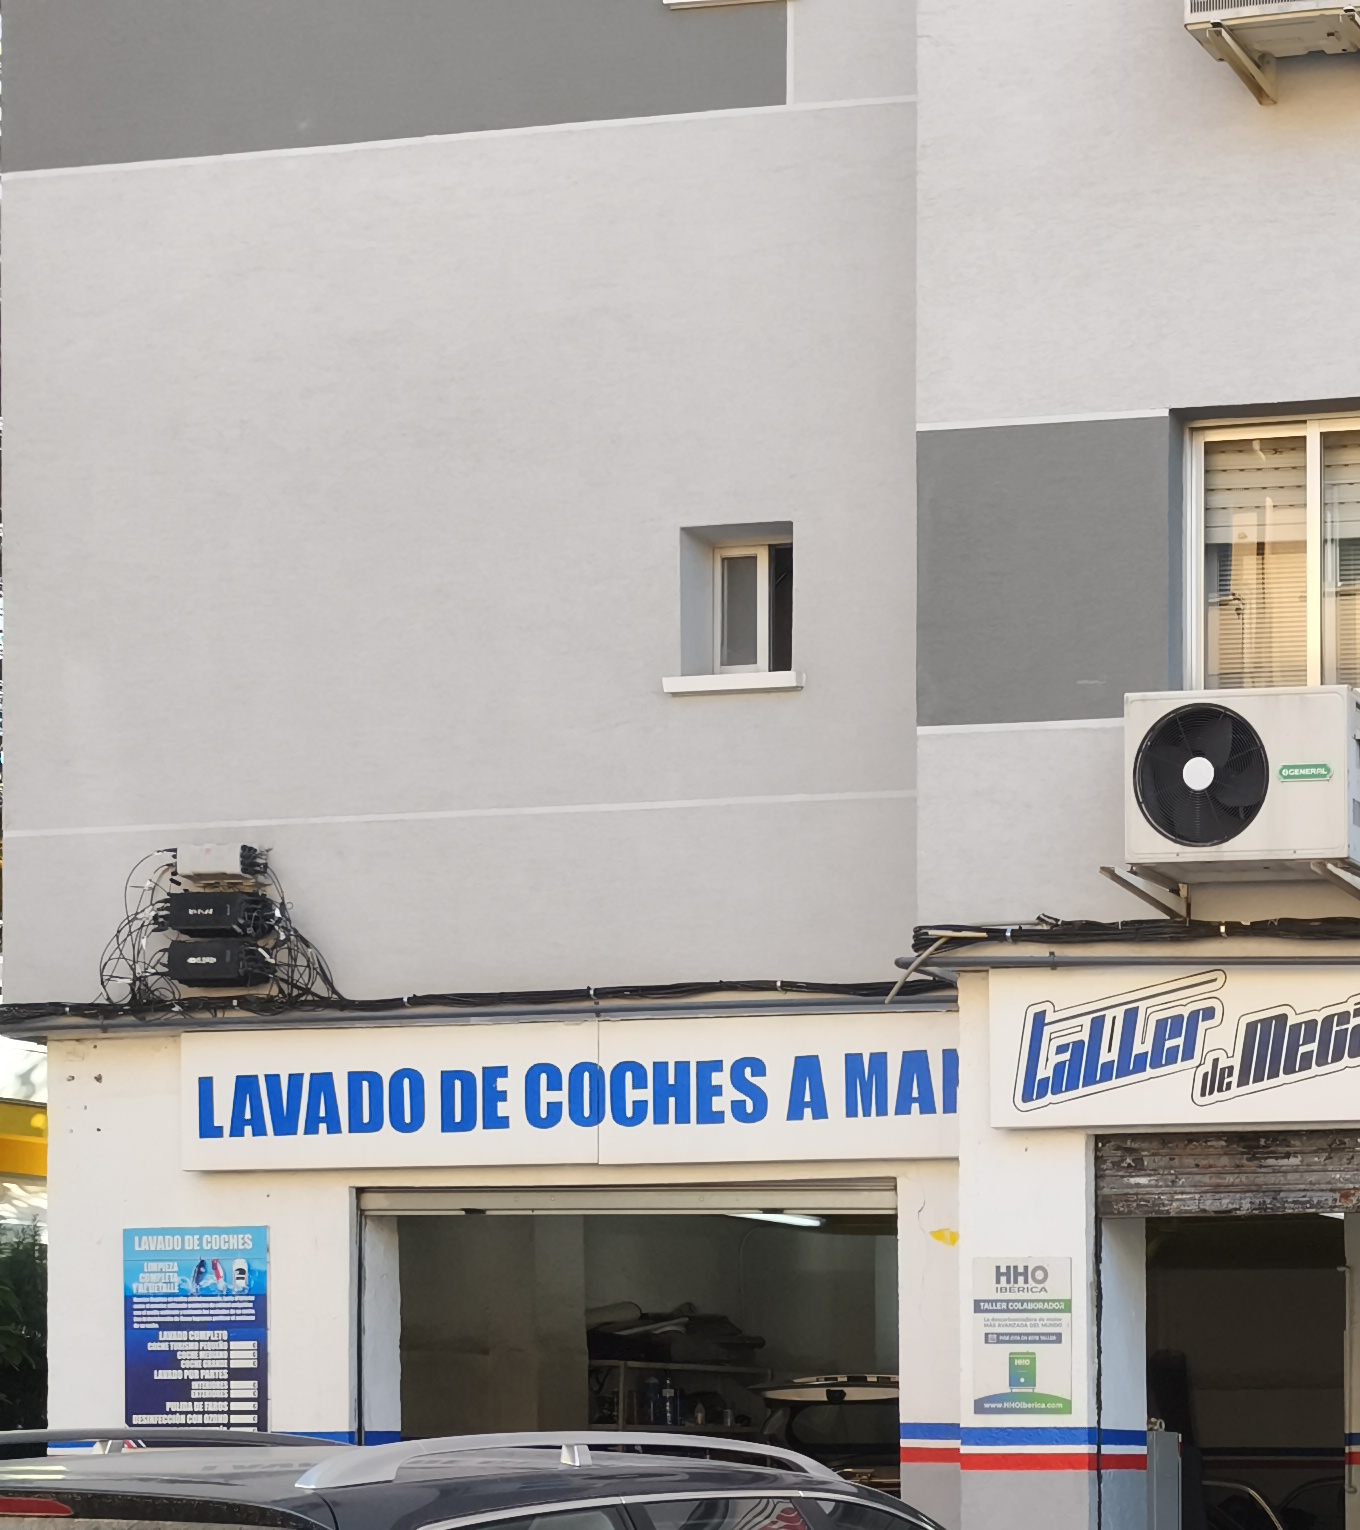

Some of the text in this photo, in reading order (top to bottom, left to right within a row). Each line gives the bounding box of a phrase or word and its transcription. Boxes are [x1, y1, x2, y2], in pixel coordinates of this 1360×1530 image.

[1288, 768, 1328, 776] GENERAL
[198, 1068, 426, 1139] LAVADO
[440, 1066, 509, 1134] DE
[524, 1056, 768, 1129] COCHES
[785, 1054, 828, 1120] A
[134, 1234, 252, 1250] LAVADO DE COCHES
[995, 1265, 1048, 1285] HHO
[996, 1285, 1048, 1294] IBÉRICA
[980, 1302, 1064, 1310] TALLER COLABORADOR
